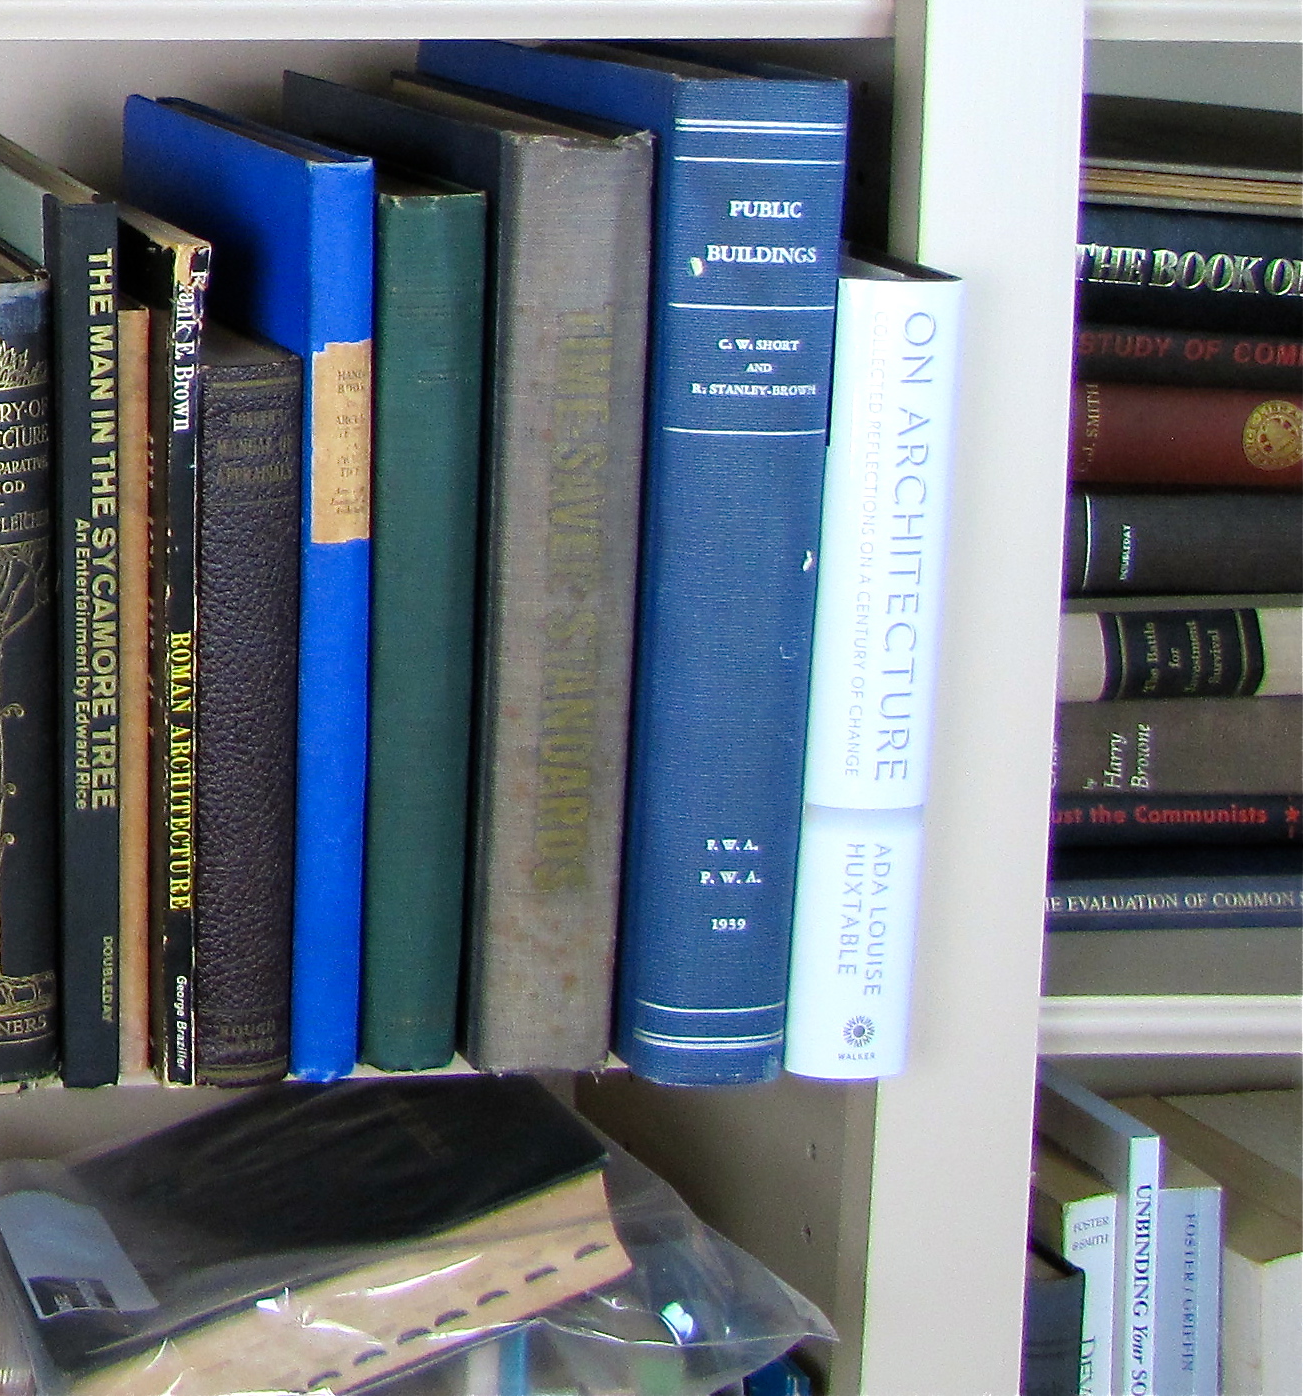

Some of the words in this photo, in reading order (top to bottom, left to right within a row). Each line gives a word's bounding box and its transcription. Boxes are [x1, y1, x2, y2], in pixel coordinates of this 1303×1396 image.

[728, 199, 804, 219] PUBLIC
[87, 246, 115, 316] THE
[705, 243, 817, 265] BUILDINGS
[1148, 247, 1265, 295] BOOK
[88, 323, 116, 401] MAN
[745, 362, 774, 374] AND
[755, 338, 801, 352] SHORT
[867, 310, 889, 414] COLLECTED
[900, 310, 938, 385] ON
[1183, 337, 1226, 362] OF
[172, 363, 196, 432] Brown
[708, 383, 817, 397] STANLEY-BROWN
[90, 409, 117, 444] IN
[90, 449, 118, 520] THE
[74, 546, 91, 674] Entertainment
[90, 526, 118, 718] SYCAMORE
[873, 406, 932, 782] ARCHITECTURE
[852, 590, 872, 671] CENTURY
[169, 629, 193, 714] ROMAN
[74, 701, 91, 769] Edward
[90, 724, 118, 811] TREE
[1102, 731, 1128, 790] Harry
[1129, 722, 1151, 791] Browne
[75, 770, 91, 811] Rice
[168, 721, 193, 912] ARCHITECTURE
[1133, 804, 1269, 825] Communists
[870, 842, 893, 897] ADA
[1067, 893, 1178, 913] EVALUATION
[1212, 890, 1293, 909] COMMON
[710, 917, 747, 931] 1939
[836, 842, 866, 977] HUXTABLE
[101, 935, 114, 1023] DOUBLEDAY
[862, 905, 888, 997] LOUISE
[172, 974, 188, 1017] George
[837, 1051, 876, 1062] WALKER
[1132, 1183, 1153, 1318] UNBINDING
[1131, 1322, 1149, 1365] Your
